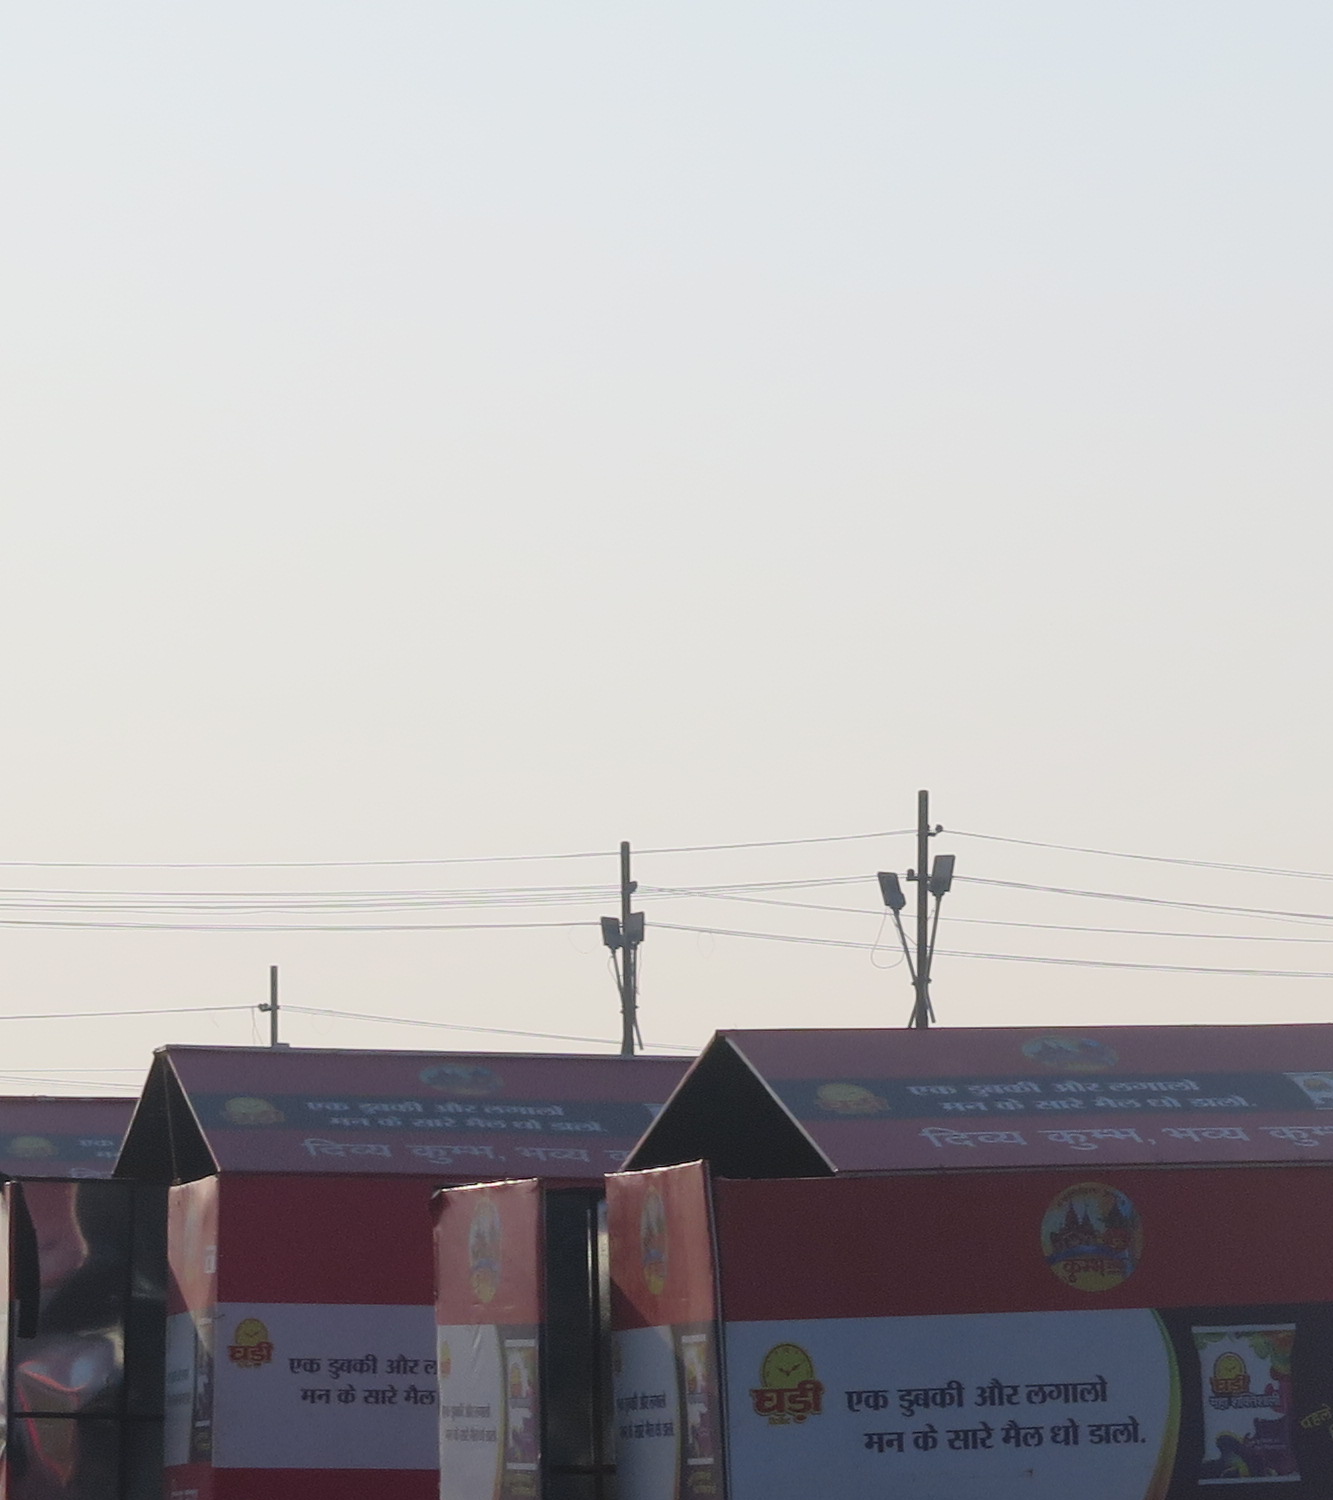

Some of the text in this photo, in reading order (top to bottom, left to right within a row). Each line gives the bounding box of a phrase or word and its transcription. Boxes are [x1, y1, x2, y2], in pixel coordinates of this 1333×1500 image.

[301, 1138, 392, 1157] दिव्य
[514, 1146, 590, 1163] भव्य
[920, 1126, 1028, 1149] दिव्य
[1037, 1128, 1155, 1151] कुम्भ,
[1162, 1126, 1250, 1143] भव्य
[289, 1354, 418, 1379] एक डुबकी और
[301, 1389, 330, 1404] मन
[338, 1384, 357, 1404] के
[363, 1385, 397, 1404] सारे
[845, 1374, 1108, 1417] एक डुबकी और लगालो
[864, 1431, 903, 1454] मन
[913, 1424, 939, 1451] के
[947, 1422, 994, 1450] सारे
[1001, 1420, 1044, 1447] मैल
[1050, 1418, 1079, 1446] धो
